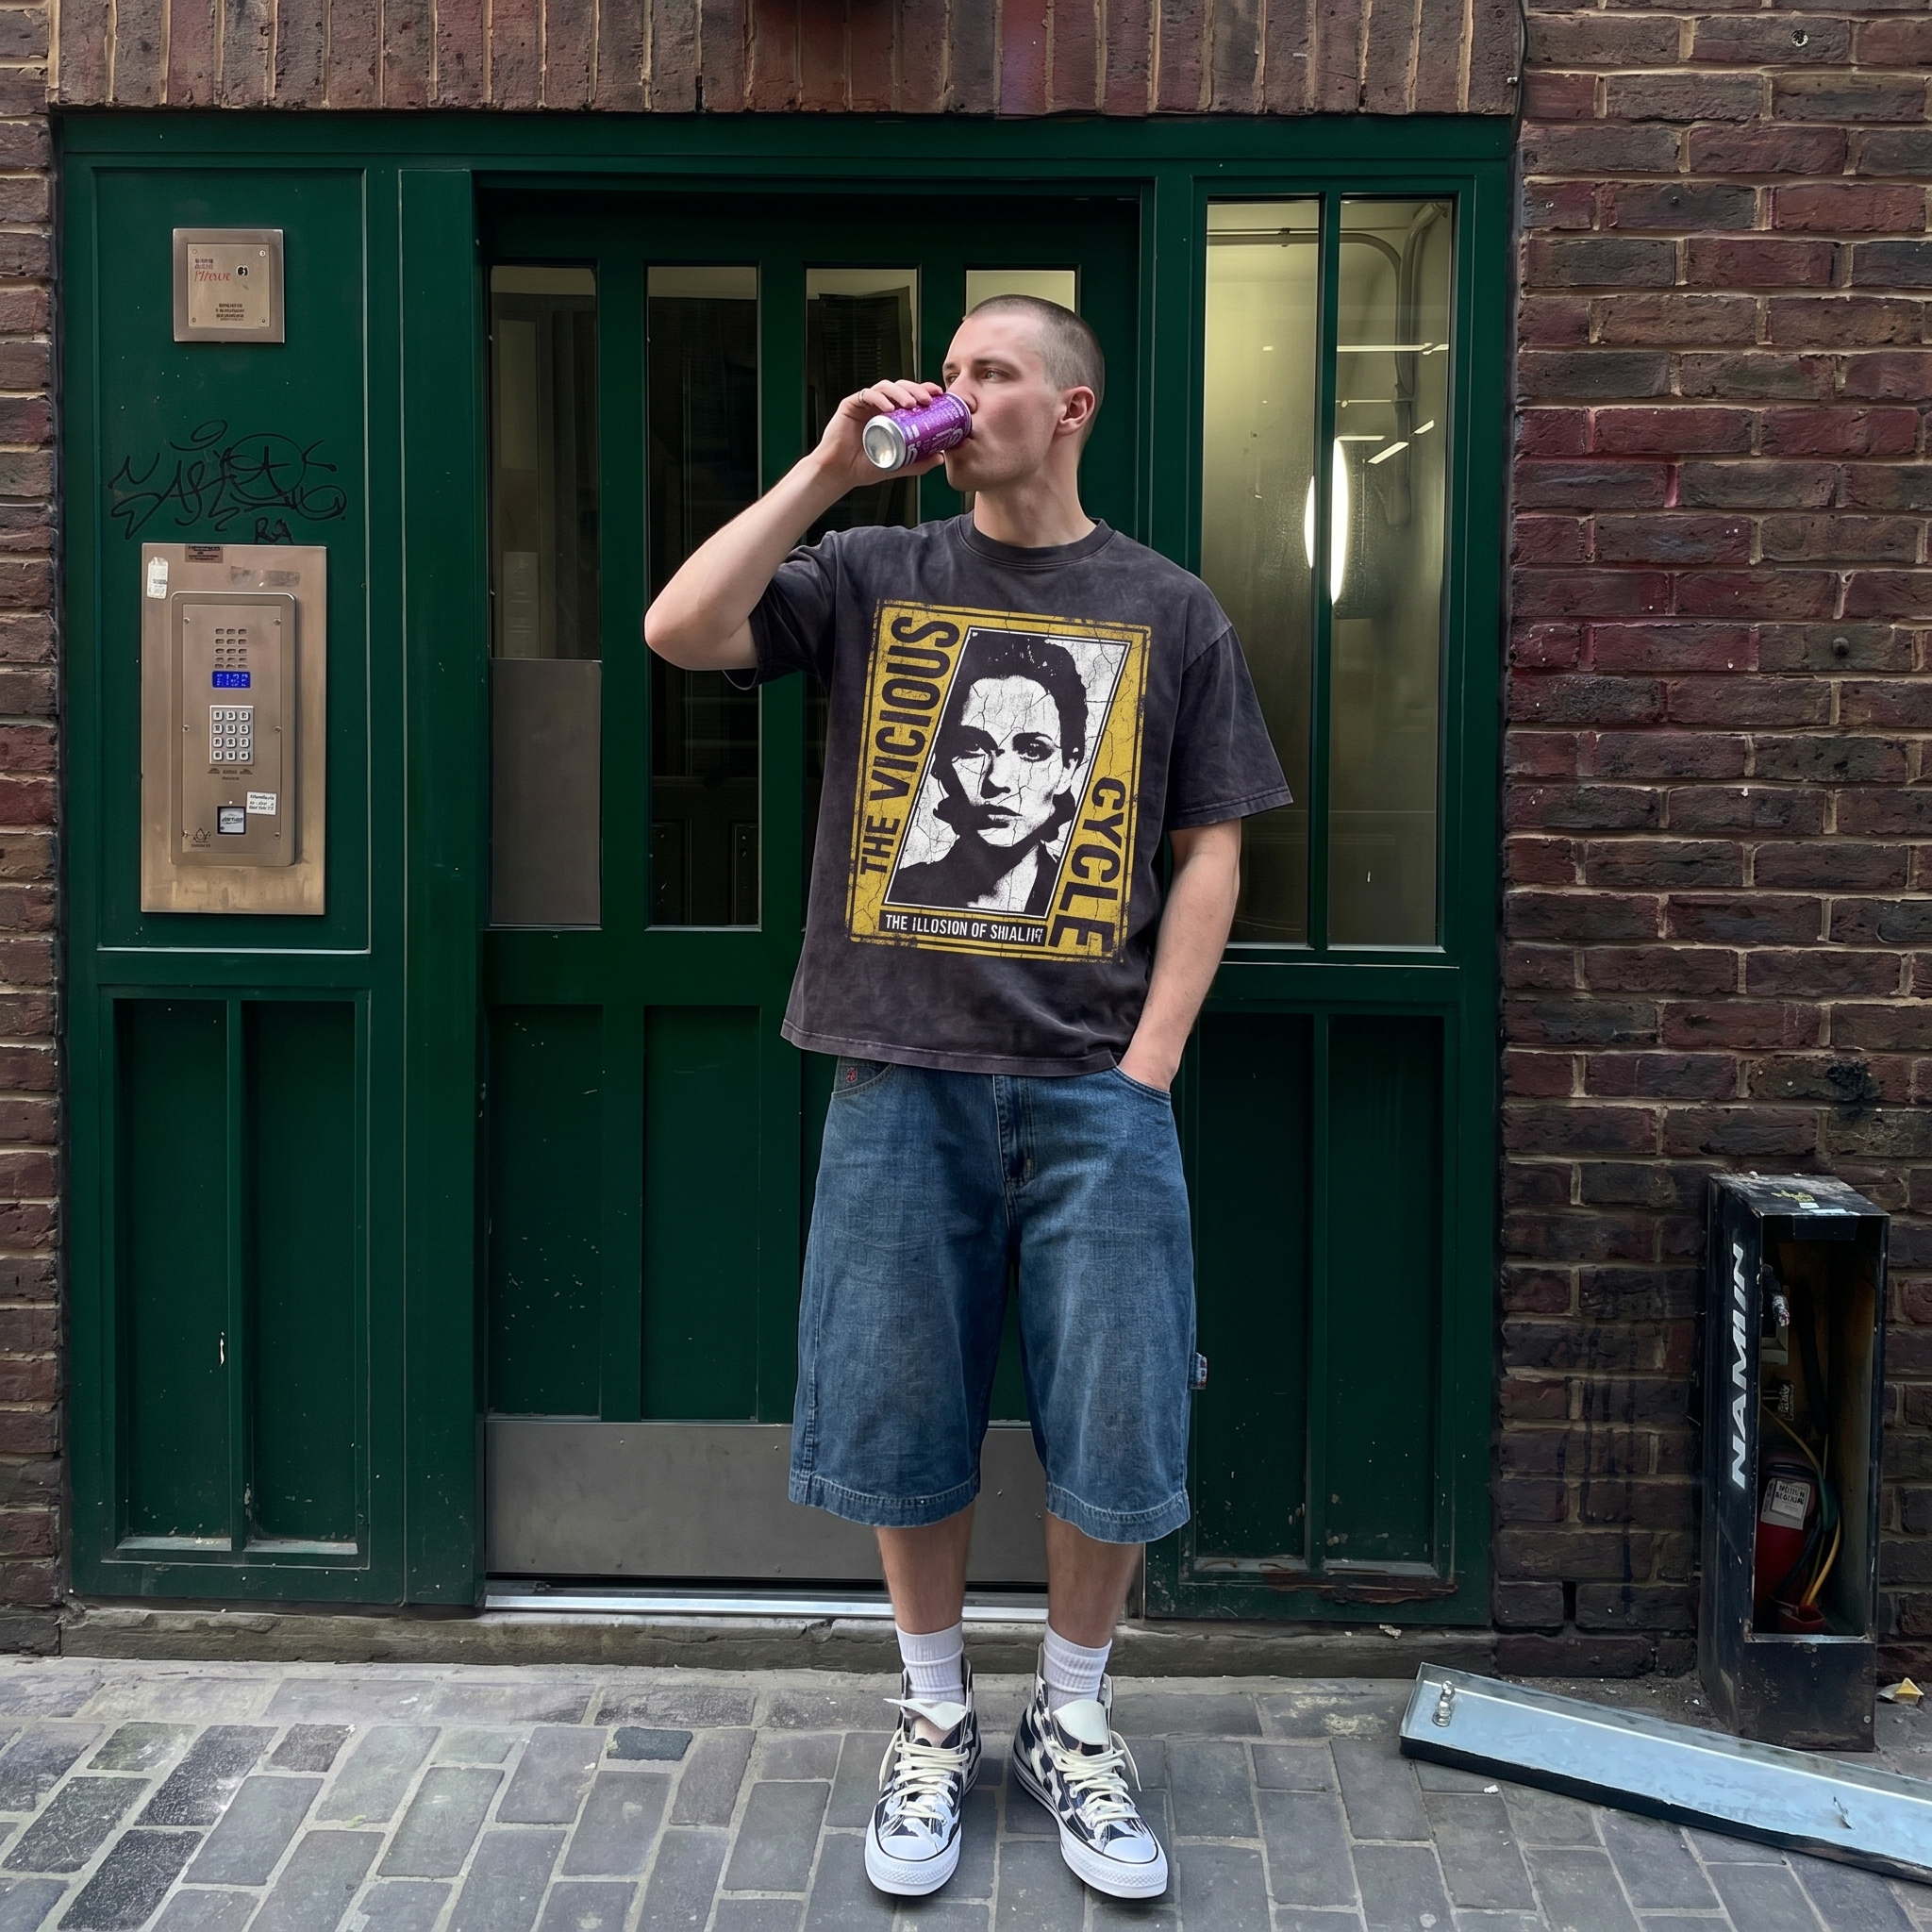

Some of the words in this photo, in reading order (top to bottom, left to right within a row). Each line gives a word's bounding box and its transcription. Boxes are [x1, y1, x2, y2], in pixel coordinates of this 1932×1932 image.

[868, 616, 960, 802] VICIOUS
[859, 814, 901, 875] THE
[1048, 776, 1126, 954] CYCLE
[885, 914, 908, 931] THE
[971, 922, 988, 939] OF
